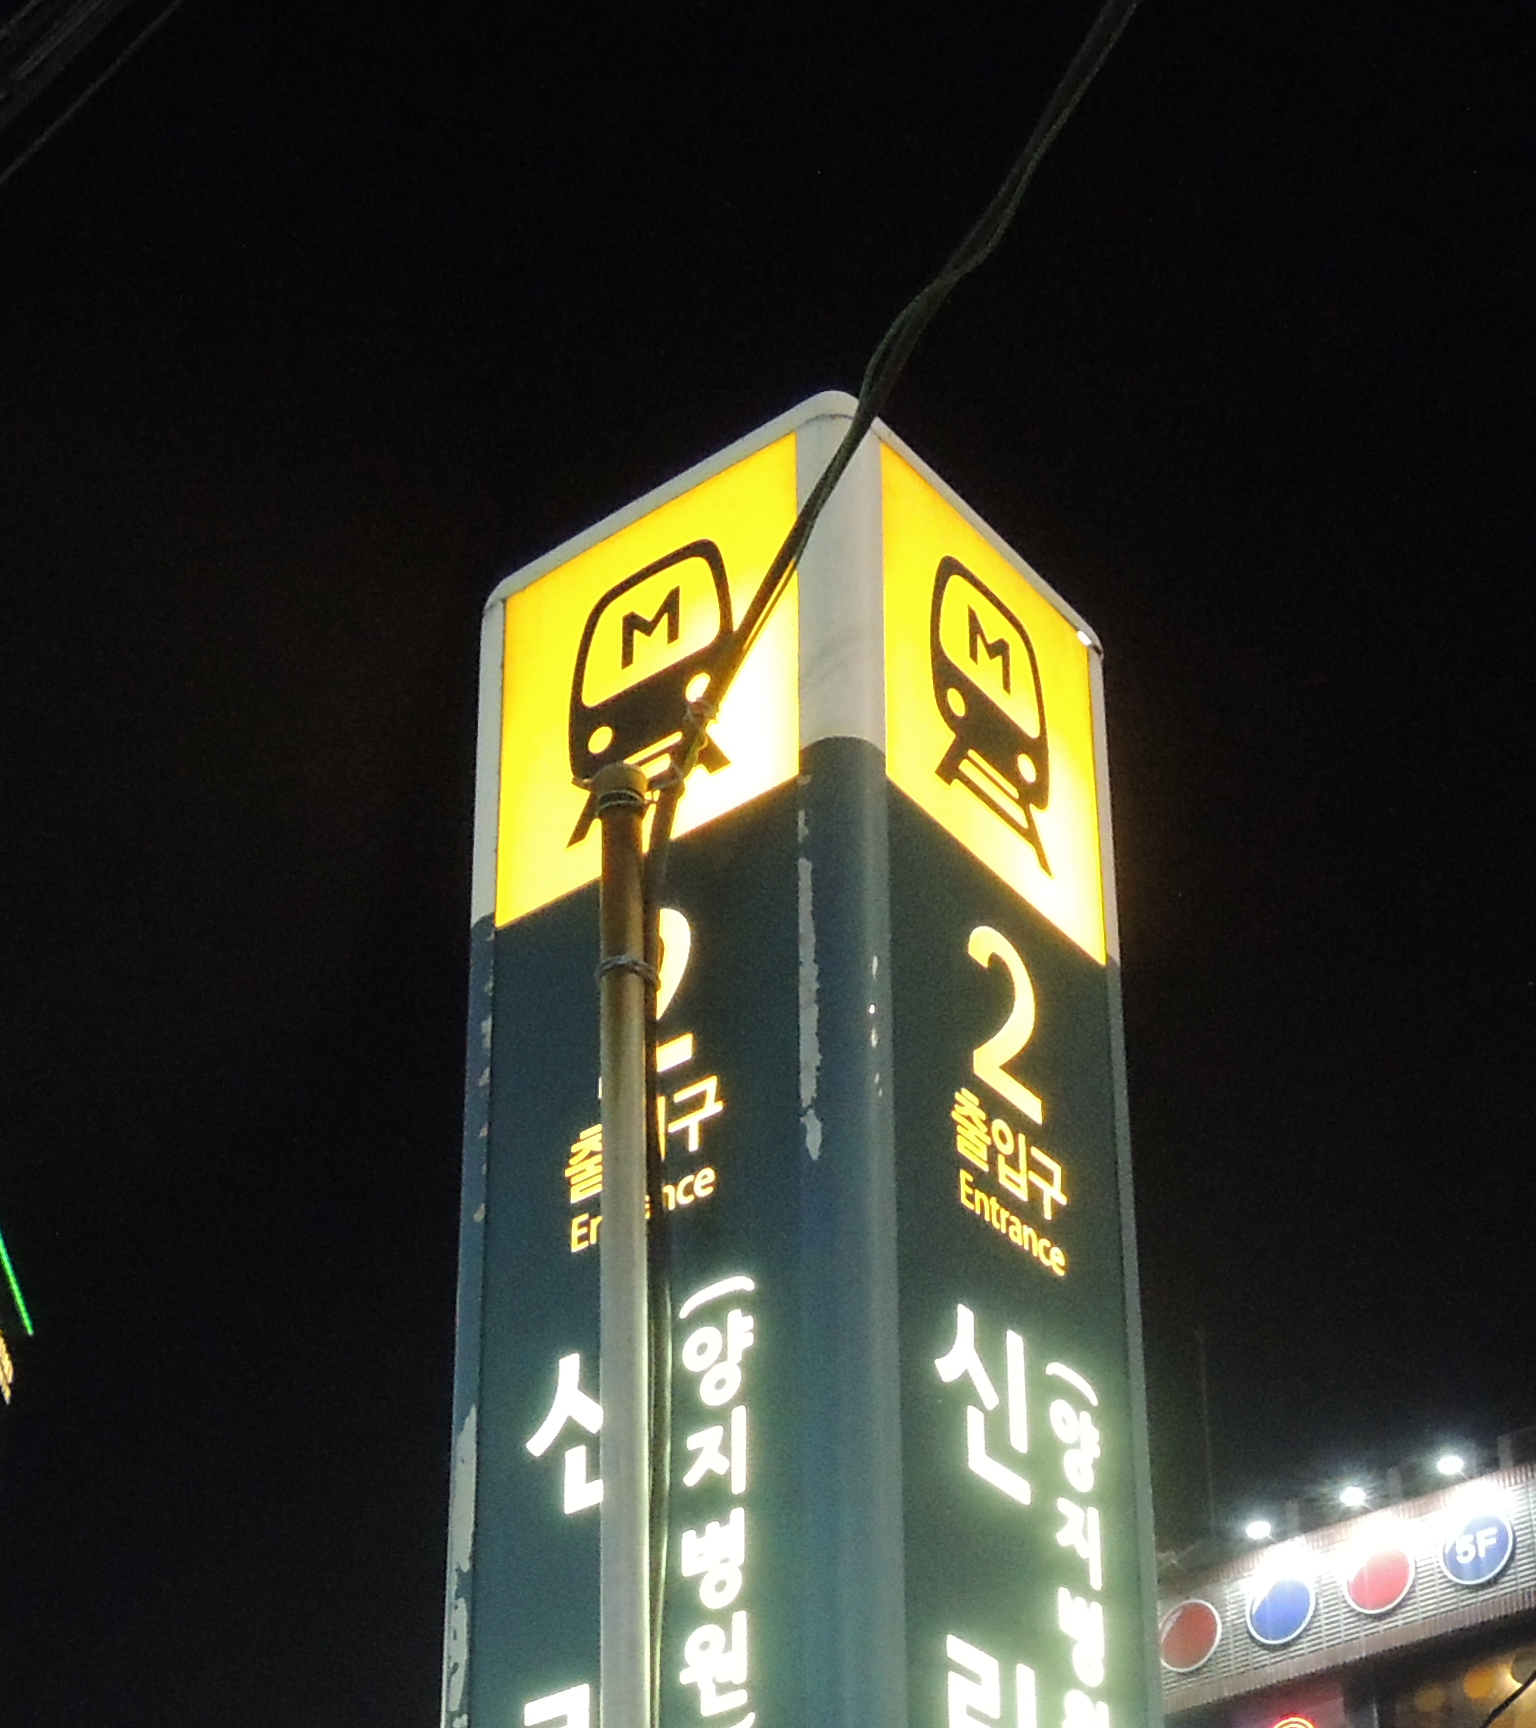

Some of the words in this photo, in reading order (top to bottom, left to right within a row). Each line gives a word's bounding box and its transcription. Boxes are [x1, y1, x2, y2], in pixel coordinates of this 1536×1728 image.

[967, 925, 1043, 1125] 2
[565, 1075, 724, 1203] 출구
[951, 1087, 1068, 1222] 출입구
[958, 1169, 1067, 1279] Entrance
[1455, 1527, 1499, 1564] 5F
